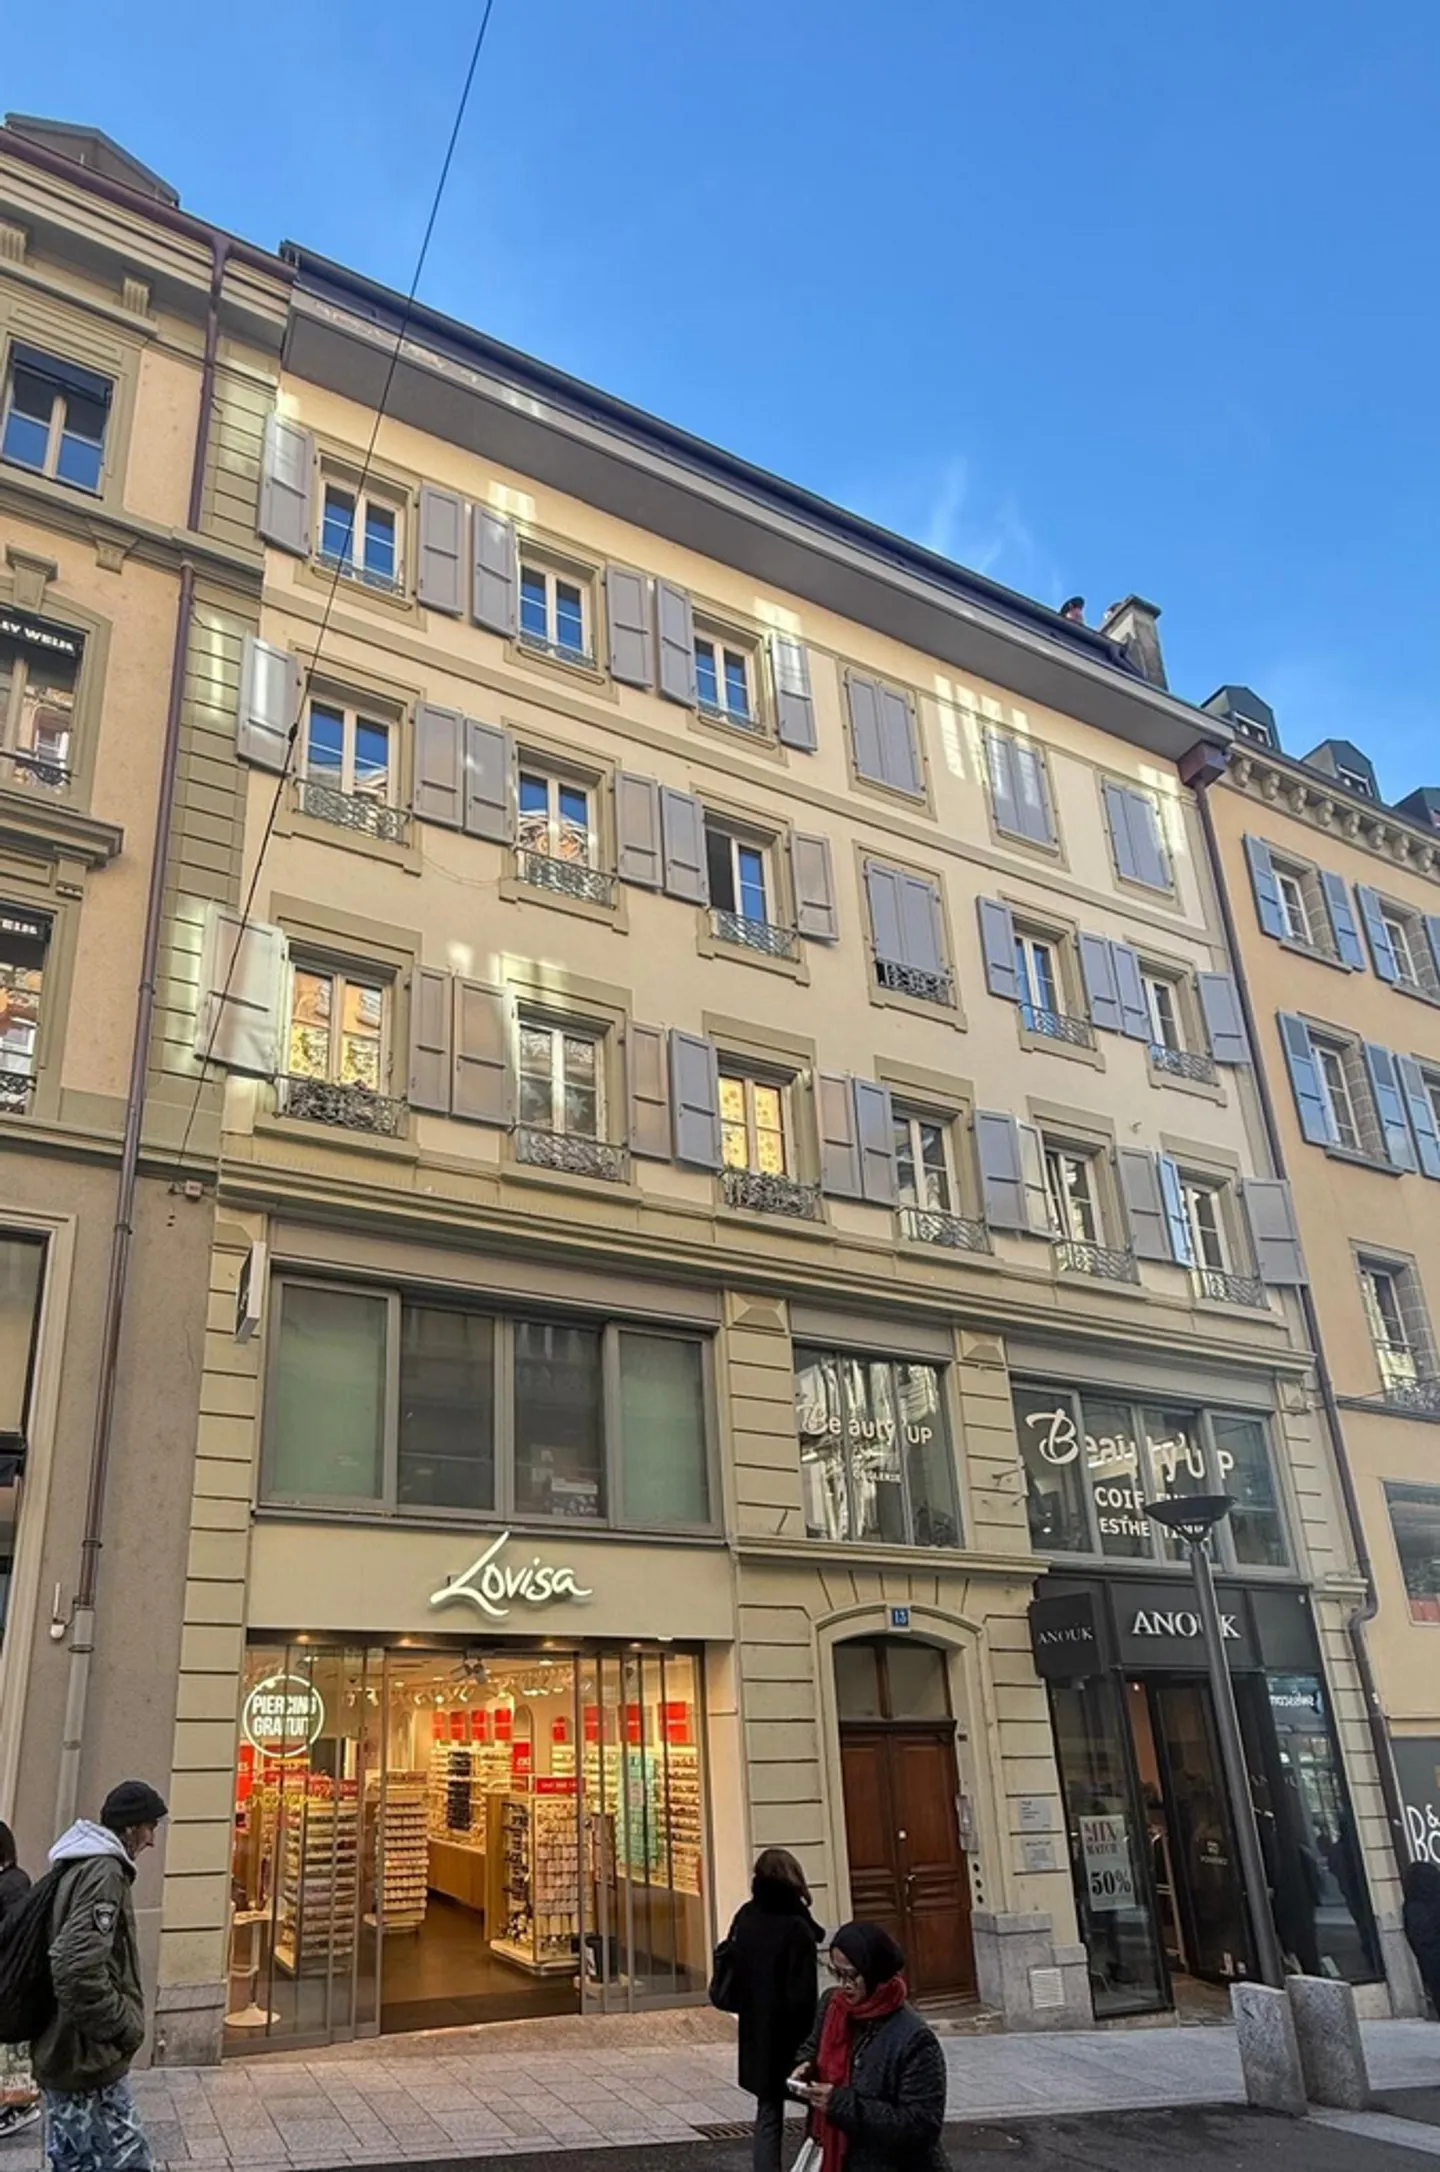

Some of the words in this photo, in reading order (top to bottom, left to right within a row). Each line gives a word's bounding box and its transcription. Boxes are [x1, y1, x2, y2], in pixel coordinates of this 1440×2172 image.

[430, 1530, 594, 1617] Lovisa
[1037, 1626, 1094, 1645] ANOUK
[1131, 1609, 1242, 1639] ANOK
[252, 1695, 318, 1715] PIERCING
[252, 1716, 310, 1737] GRATUIT
[1090, 1867, 1132, 1896] 50%
